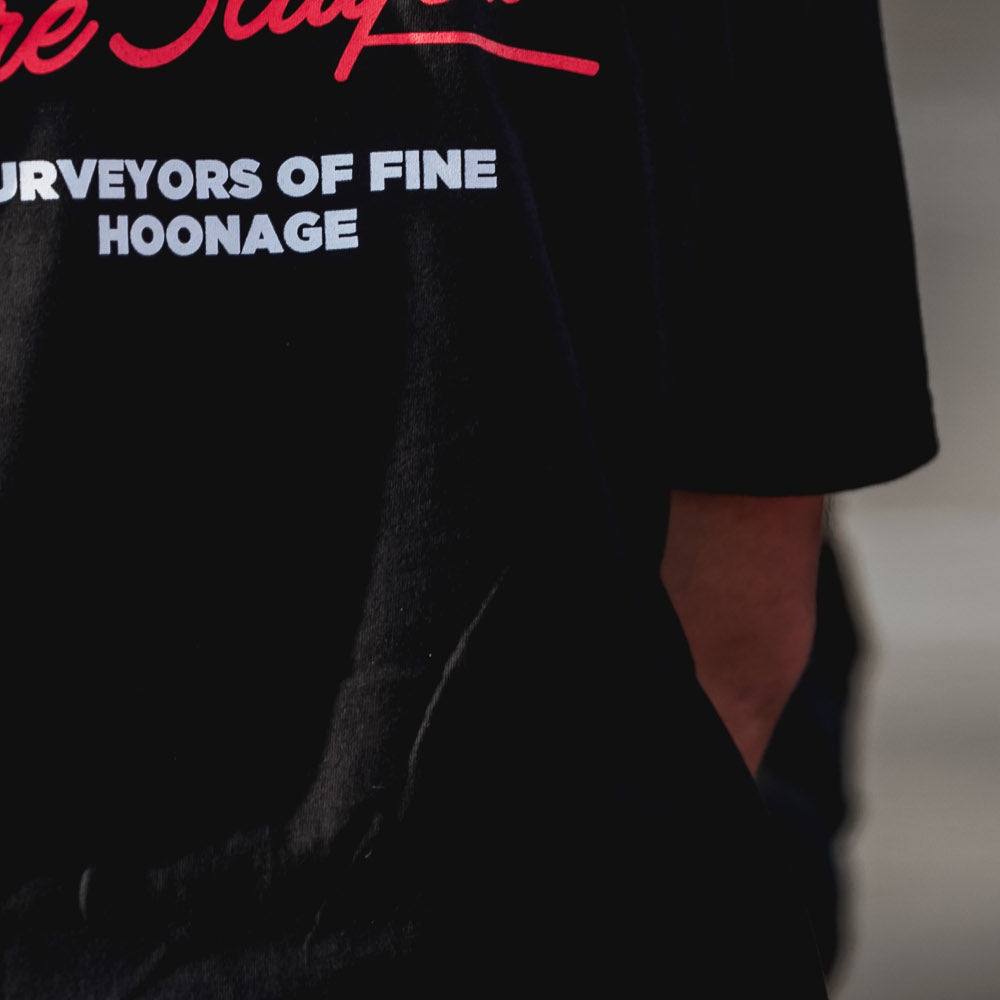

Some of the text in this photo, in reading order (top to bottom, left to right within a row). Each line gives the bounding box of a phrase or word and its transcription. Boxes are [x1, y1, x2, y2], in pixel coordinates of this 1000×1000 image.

[276, 152, 355, 199] OF
[368, 147, 499, 193] FINE
[97, 207, 360, 257] HOONAGE
